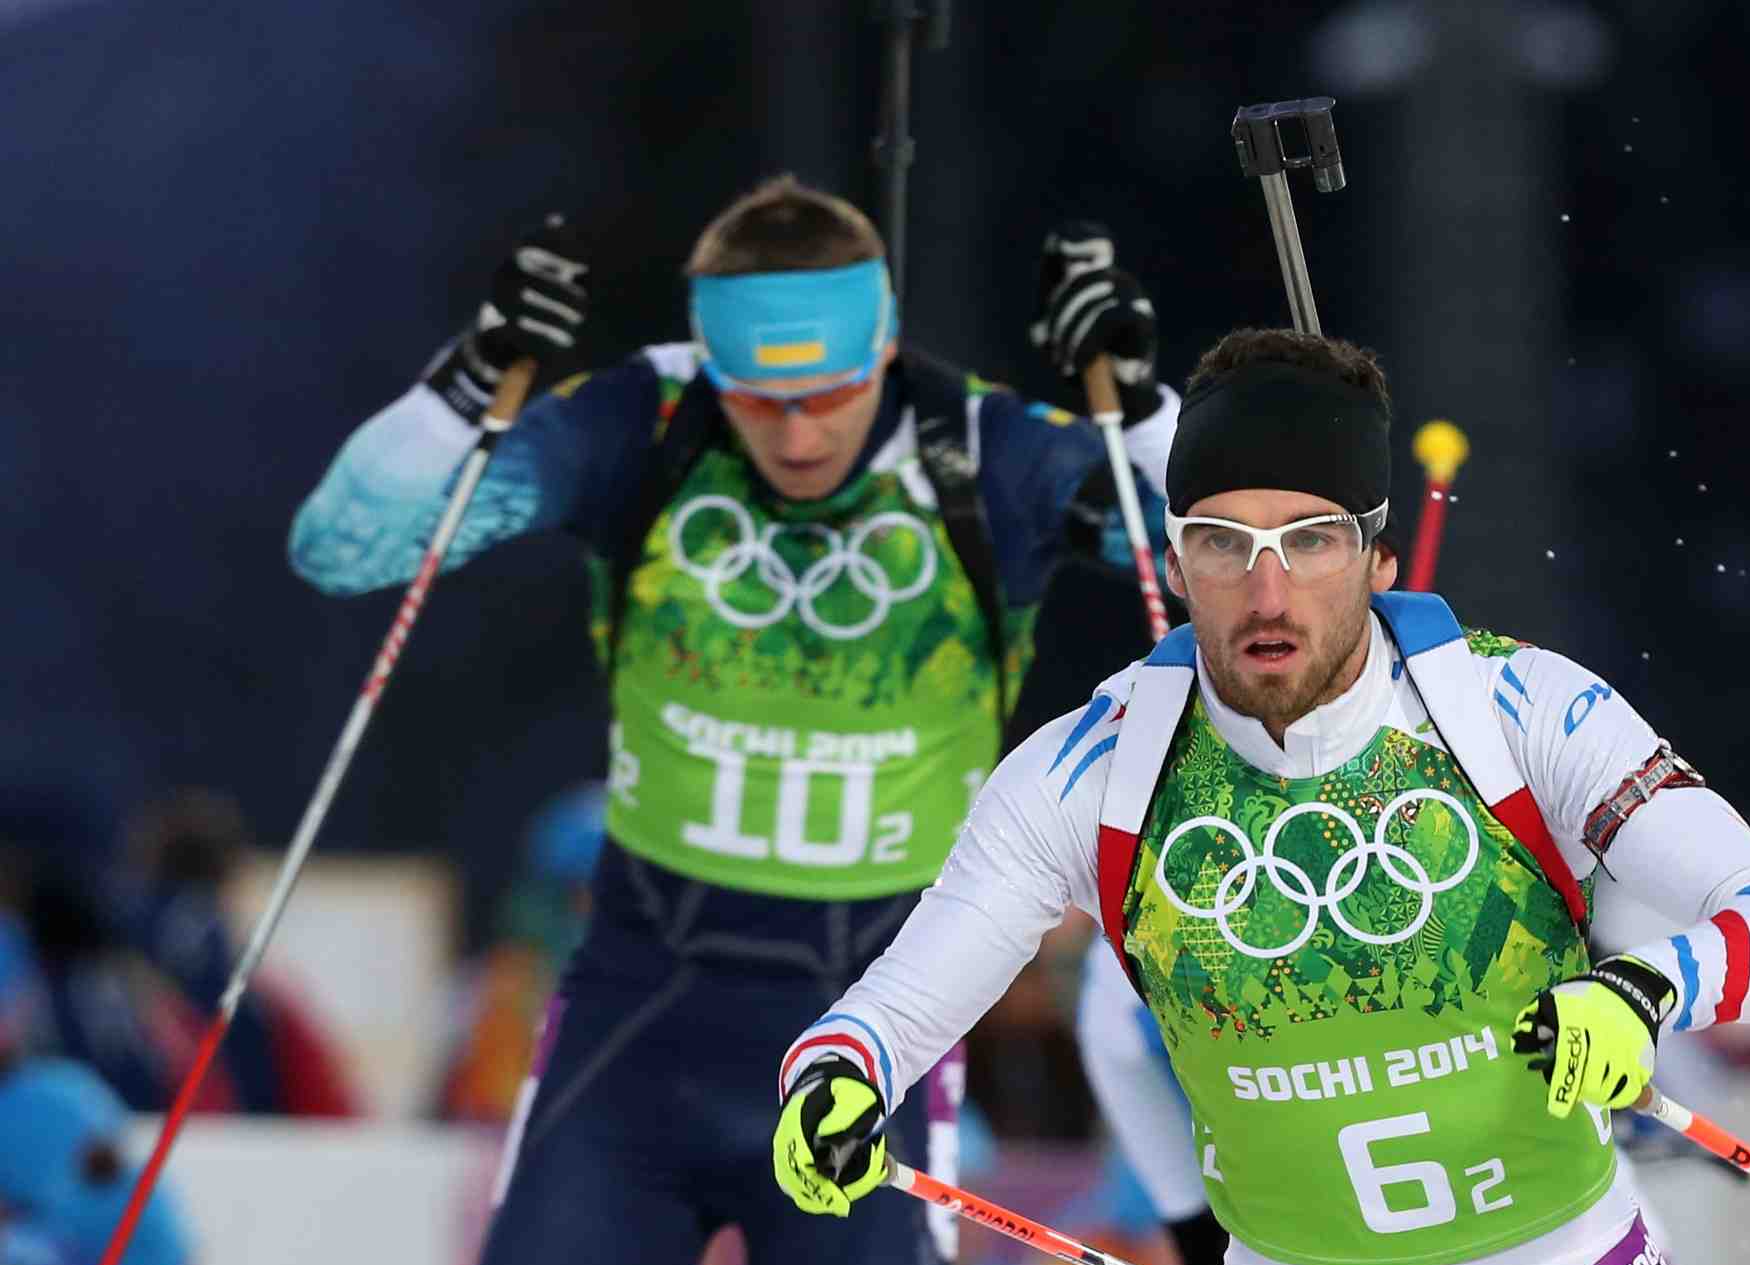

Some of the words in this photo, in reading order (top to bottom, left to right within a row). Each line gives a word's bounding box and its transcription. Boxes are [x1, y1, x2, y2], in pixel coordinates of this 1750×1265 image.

[681, 752, 876, 867] 10
[870, 812, 913, 864] 2
[1227, 1056, 1374, 1101] SOCHI
[1384, 1025, 1499, 1087] 2014
[1338, 1112, 1457, 1234] 6
[1465, 1158, 1513, 1215] 2
